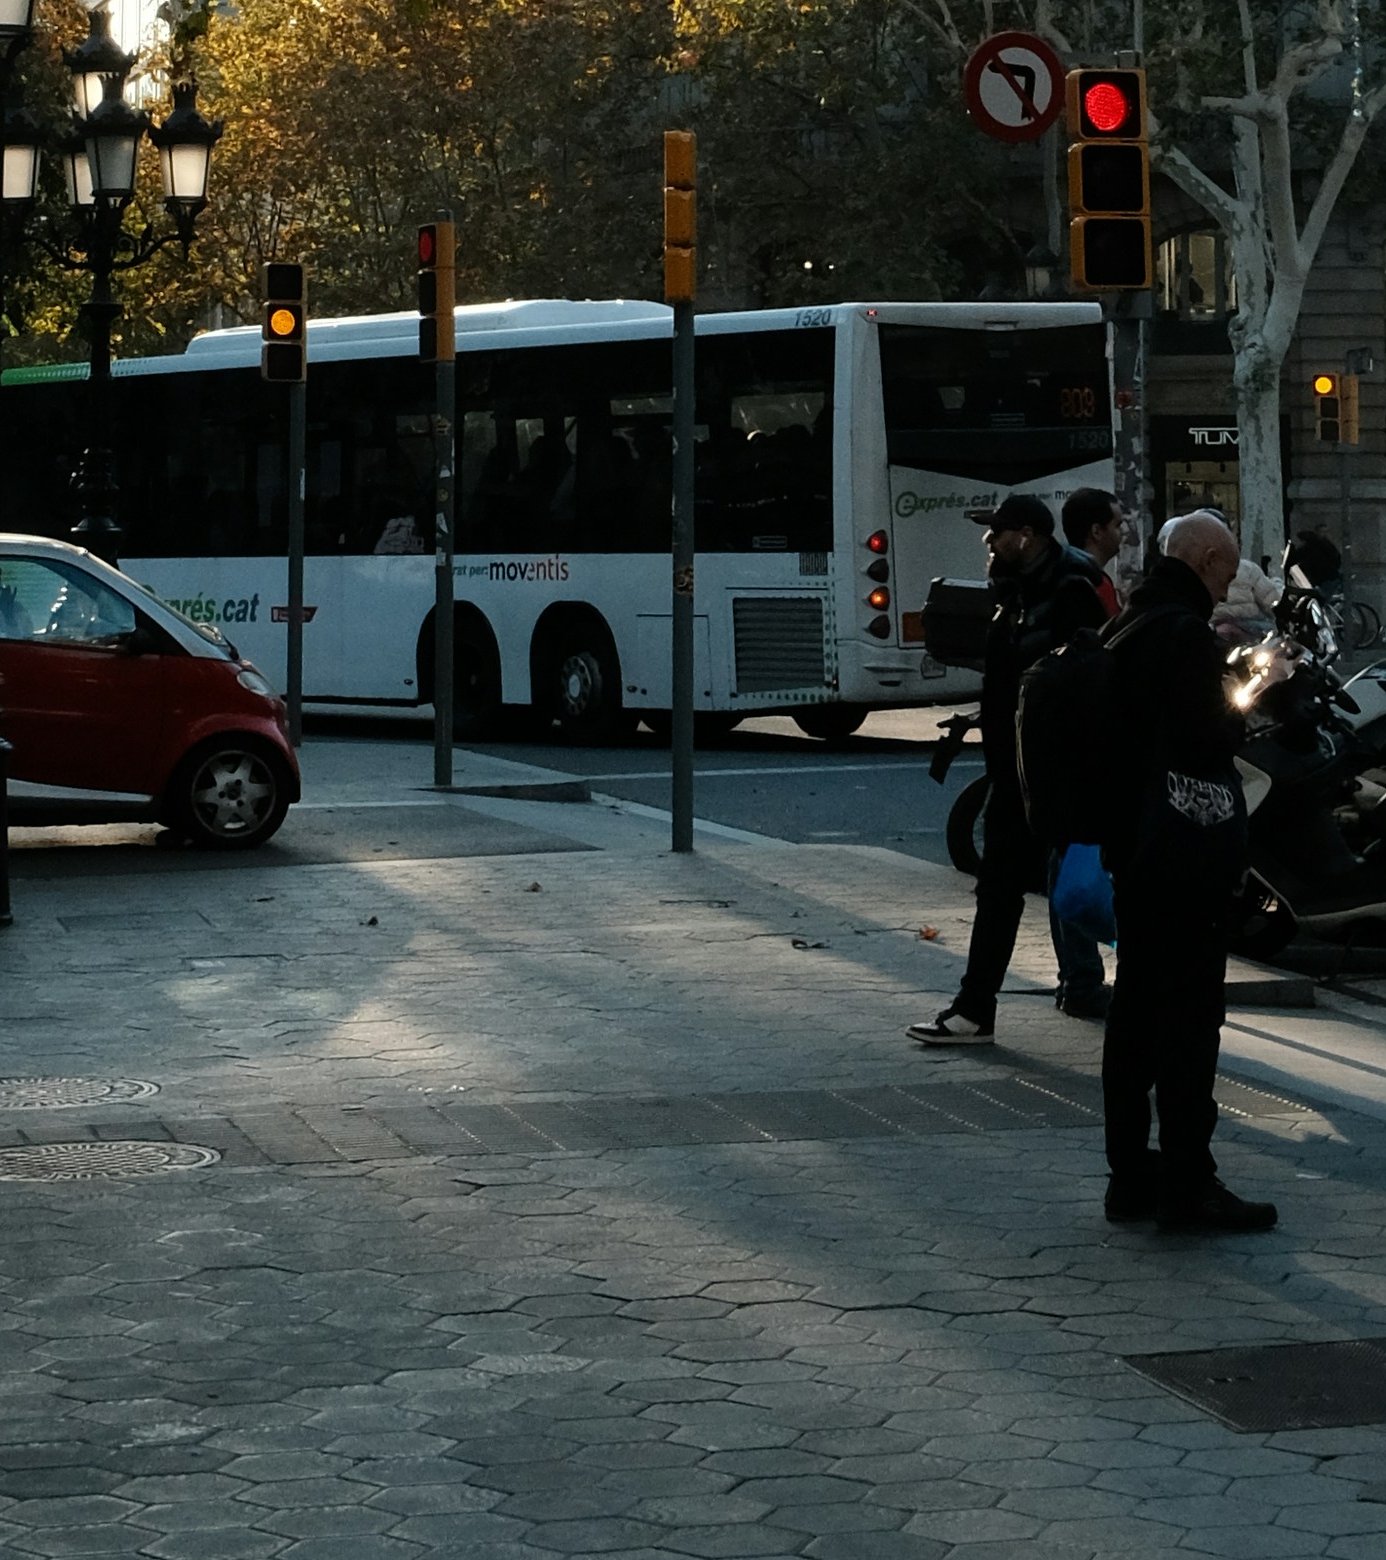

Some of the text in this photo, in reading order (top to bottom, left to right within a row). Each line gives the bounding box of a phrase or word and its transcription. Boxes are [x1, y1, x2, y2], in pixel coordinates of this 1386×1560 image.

[795, 308, 832, 327] 1520
[1069, 430, 1109, 449] 1520
[1188, 427, 1240, 445] TUM
[895, 491, 999, 518] exprés.cat
[489, 553, 569, 581] moventis
